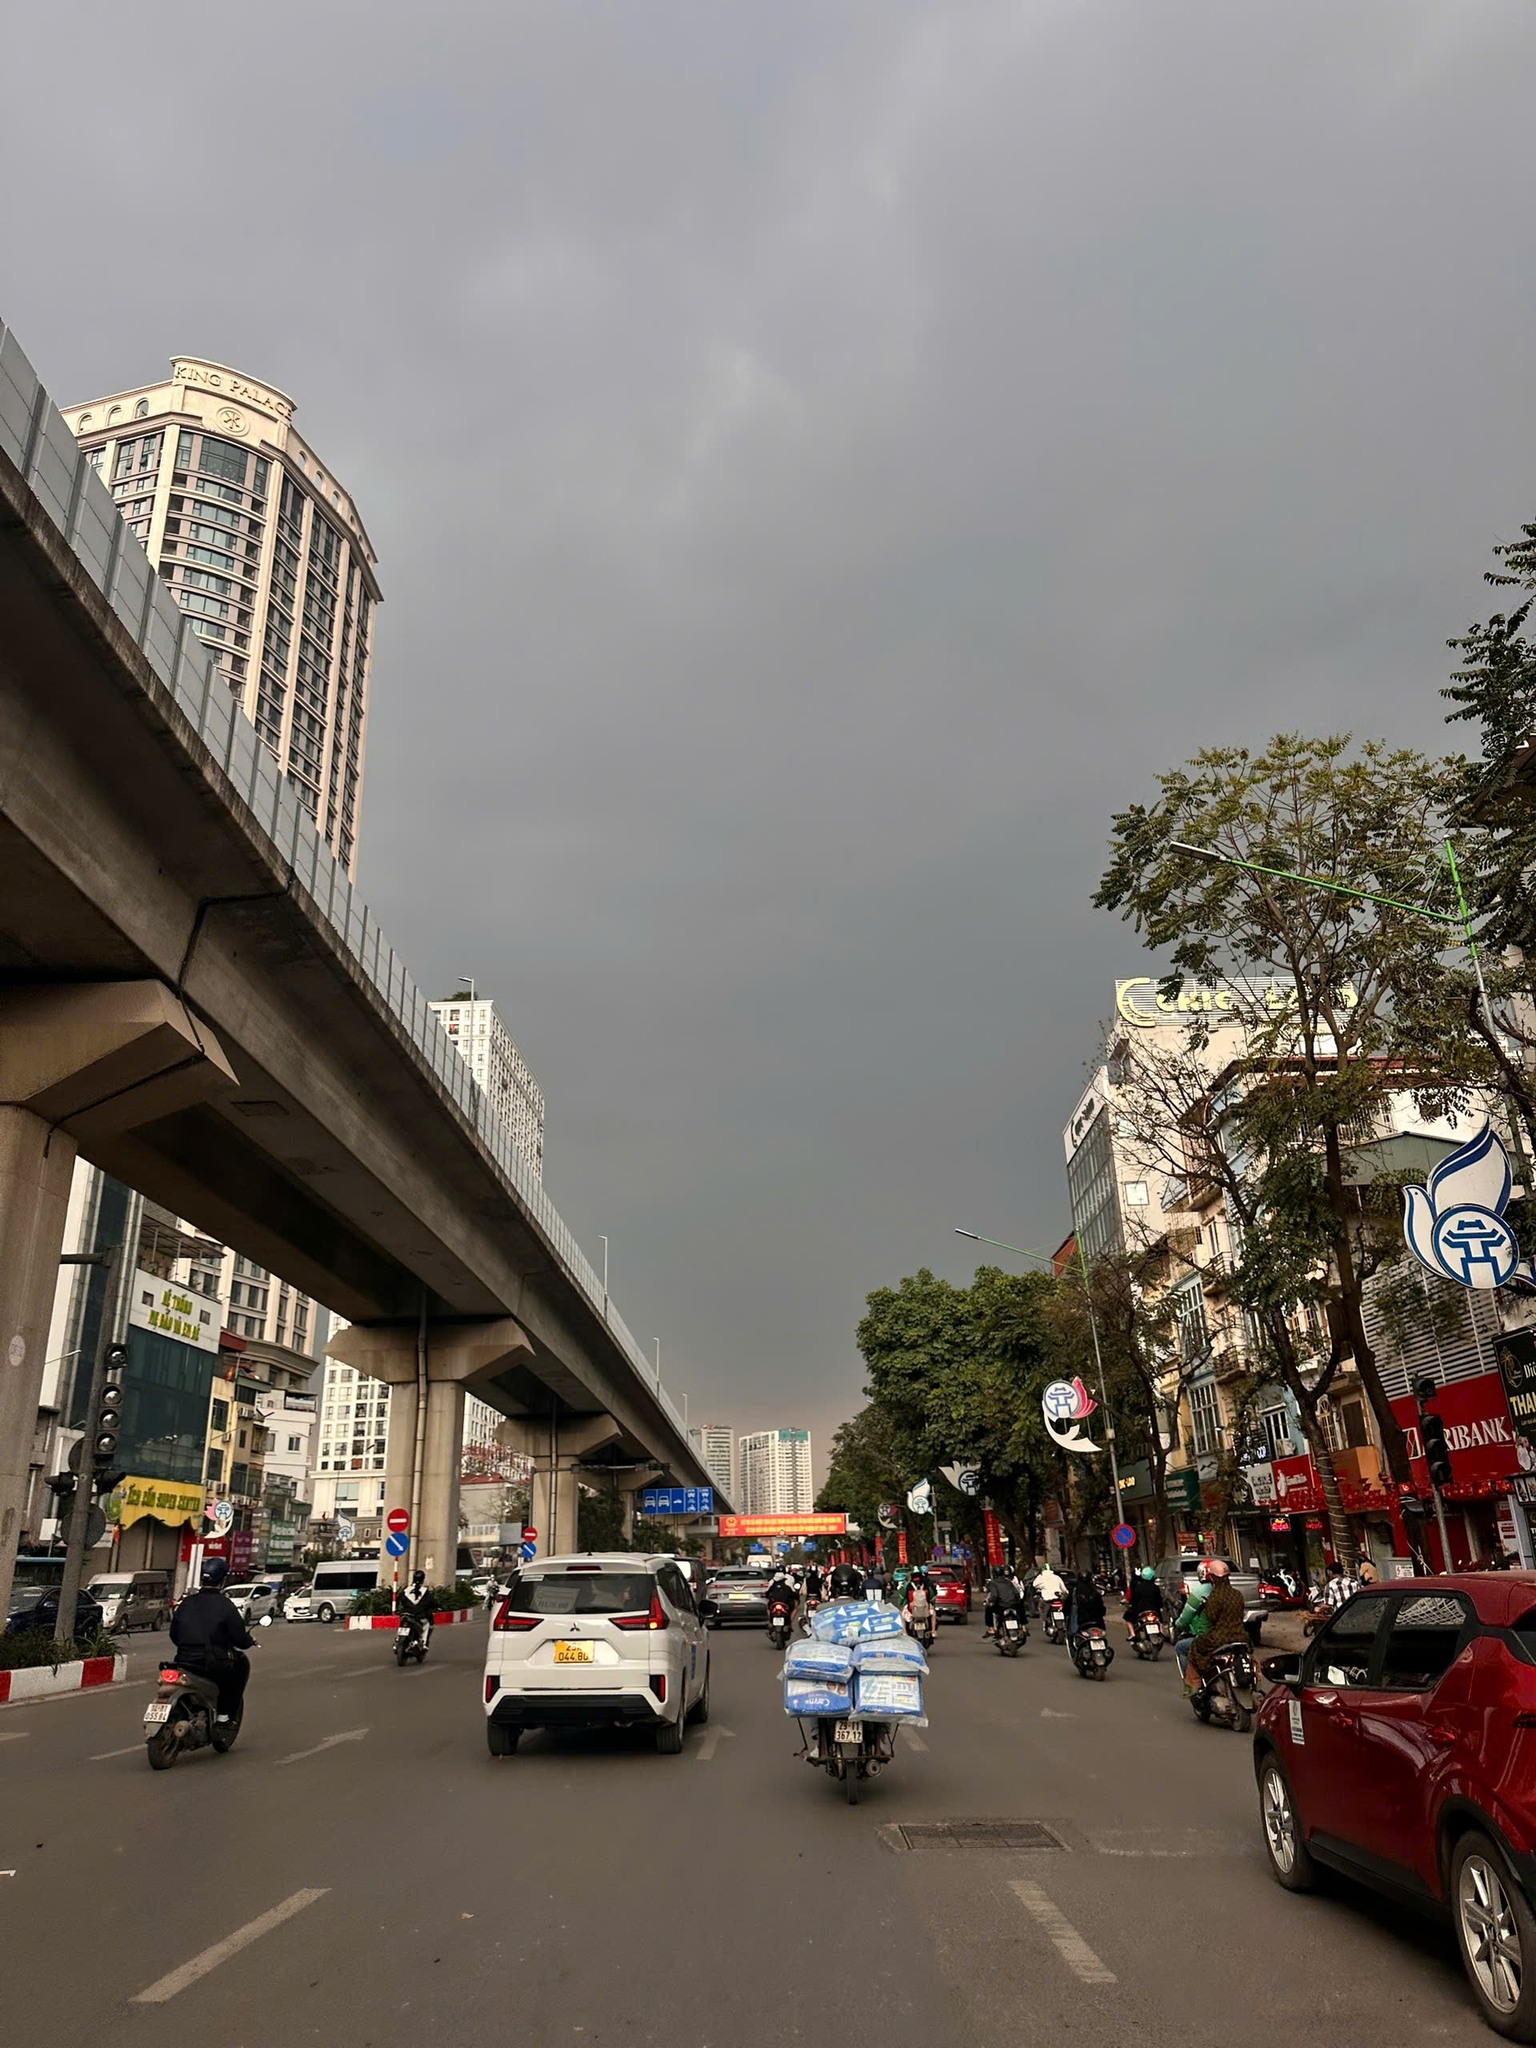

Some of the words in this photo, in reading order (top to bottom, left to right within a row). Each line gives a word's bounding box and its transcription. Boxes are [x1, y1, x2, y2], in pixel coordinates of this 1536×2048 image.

[174, 366, 222, 387] KING
[229, 379, 293, 422] PALACE
[1155, 990, 1234, 1012] CHIC
[1421, 1416, 1513, 1456] RIBANK
